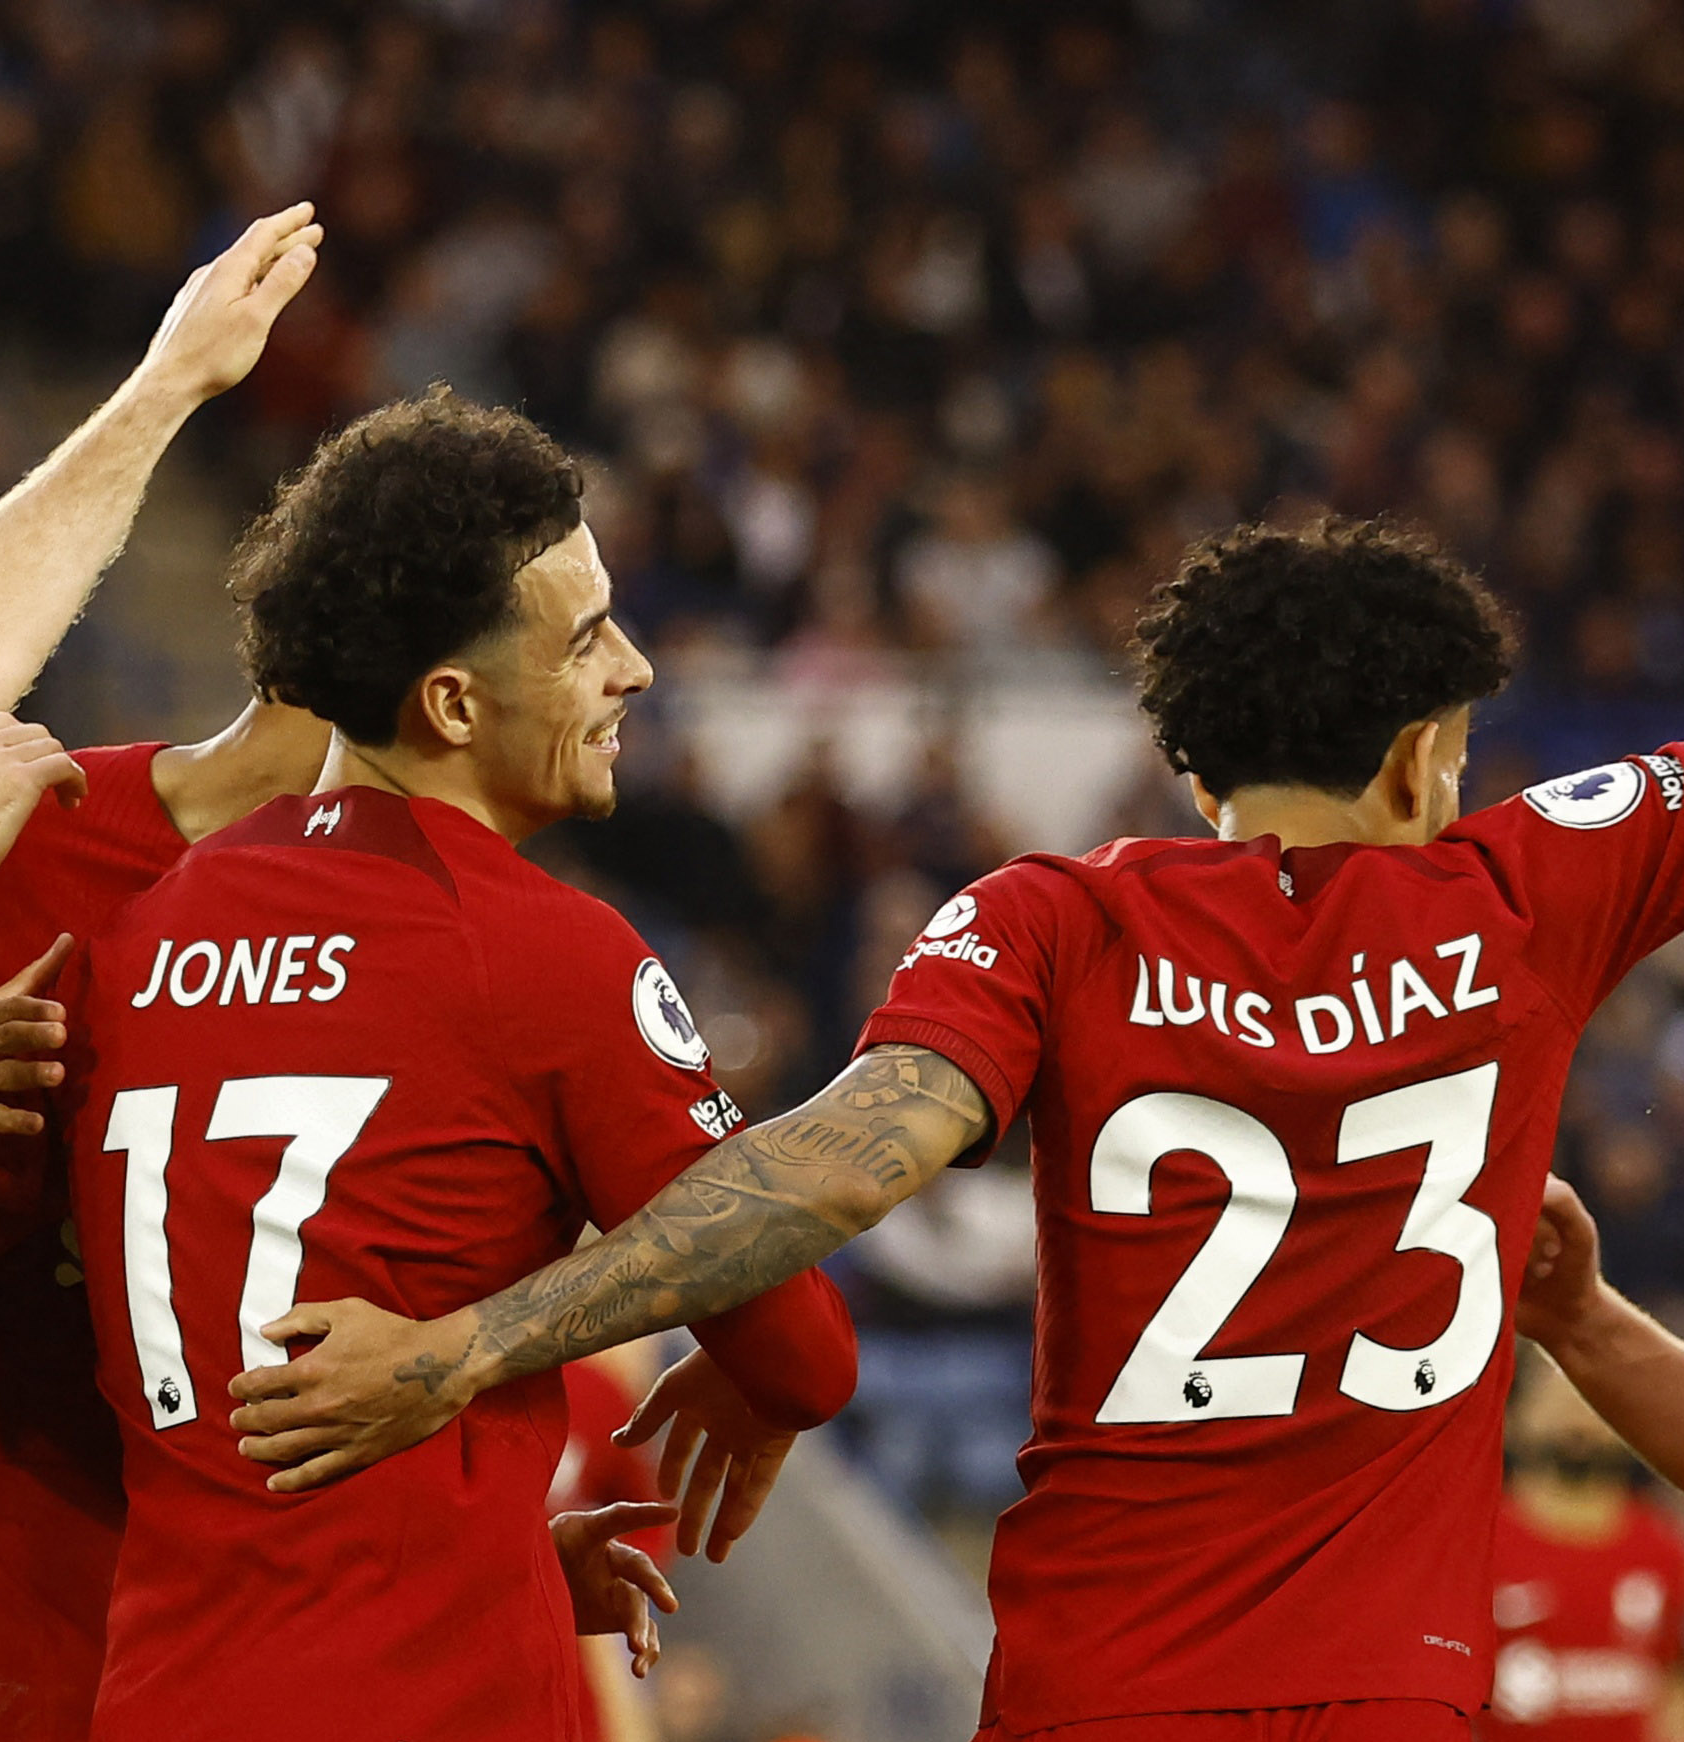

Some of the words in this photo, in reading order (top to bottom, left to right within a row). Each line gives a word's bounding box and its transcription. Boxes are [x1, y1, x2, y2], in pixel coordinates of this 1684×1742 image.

[131, 934, 356, 1008] JONES
[1128, 953, 1276, 1049] LUIS
[1294, 933, 1500, 1055] DÍAZ
[688, 1100, 718, 1123] No
[102, 1075, 393, 1430] 17
[1089, 1060, 1505, 1425] 23
